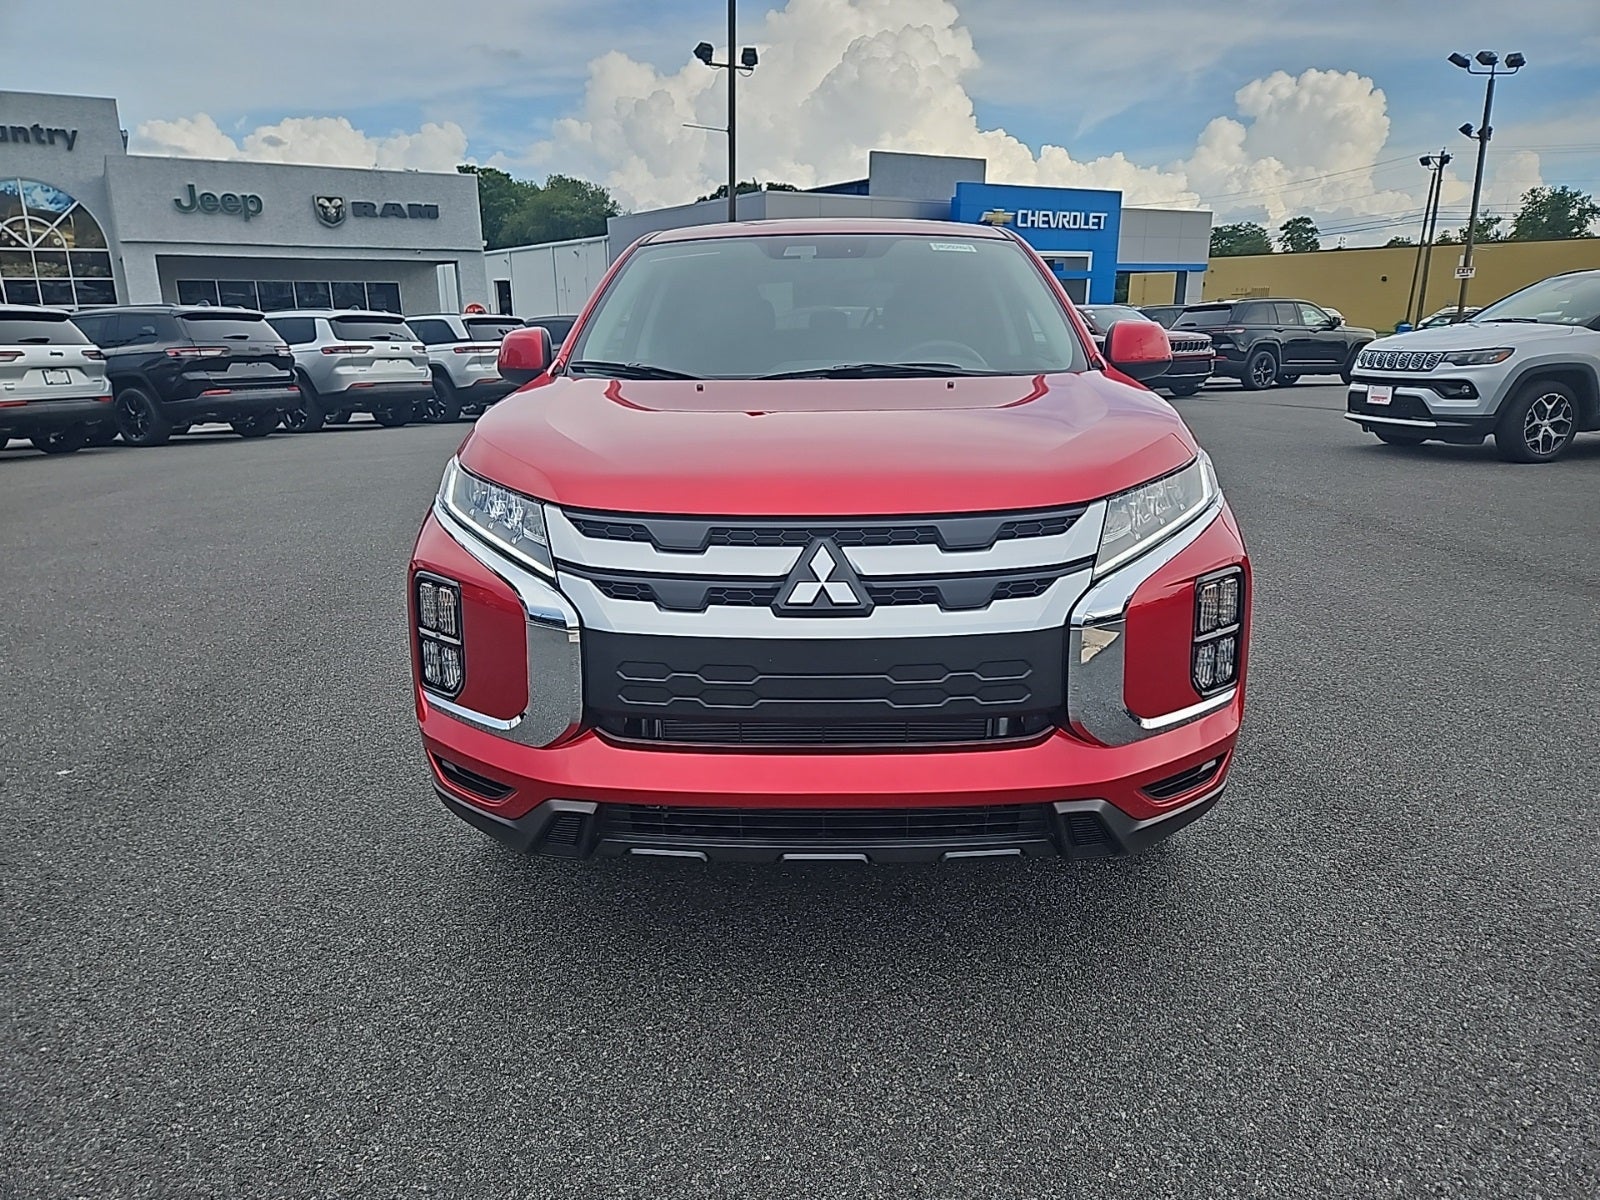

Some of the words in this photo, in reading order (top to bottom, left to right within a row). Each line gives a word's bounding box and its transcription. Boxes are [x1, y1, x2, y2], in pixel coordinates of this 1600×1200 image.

[173, 183, 263, 222] Jeep
[351, 201, 439, 219] RAM
[1017, 209, 1108, 230] CHEVROLET
